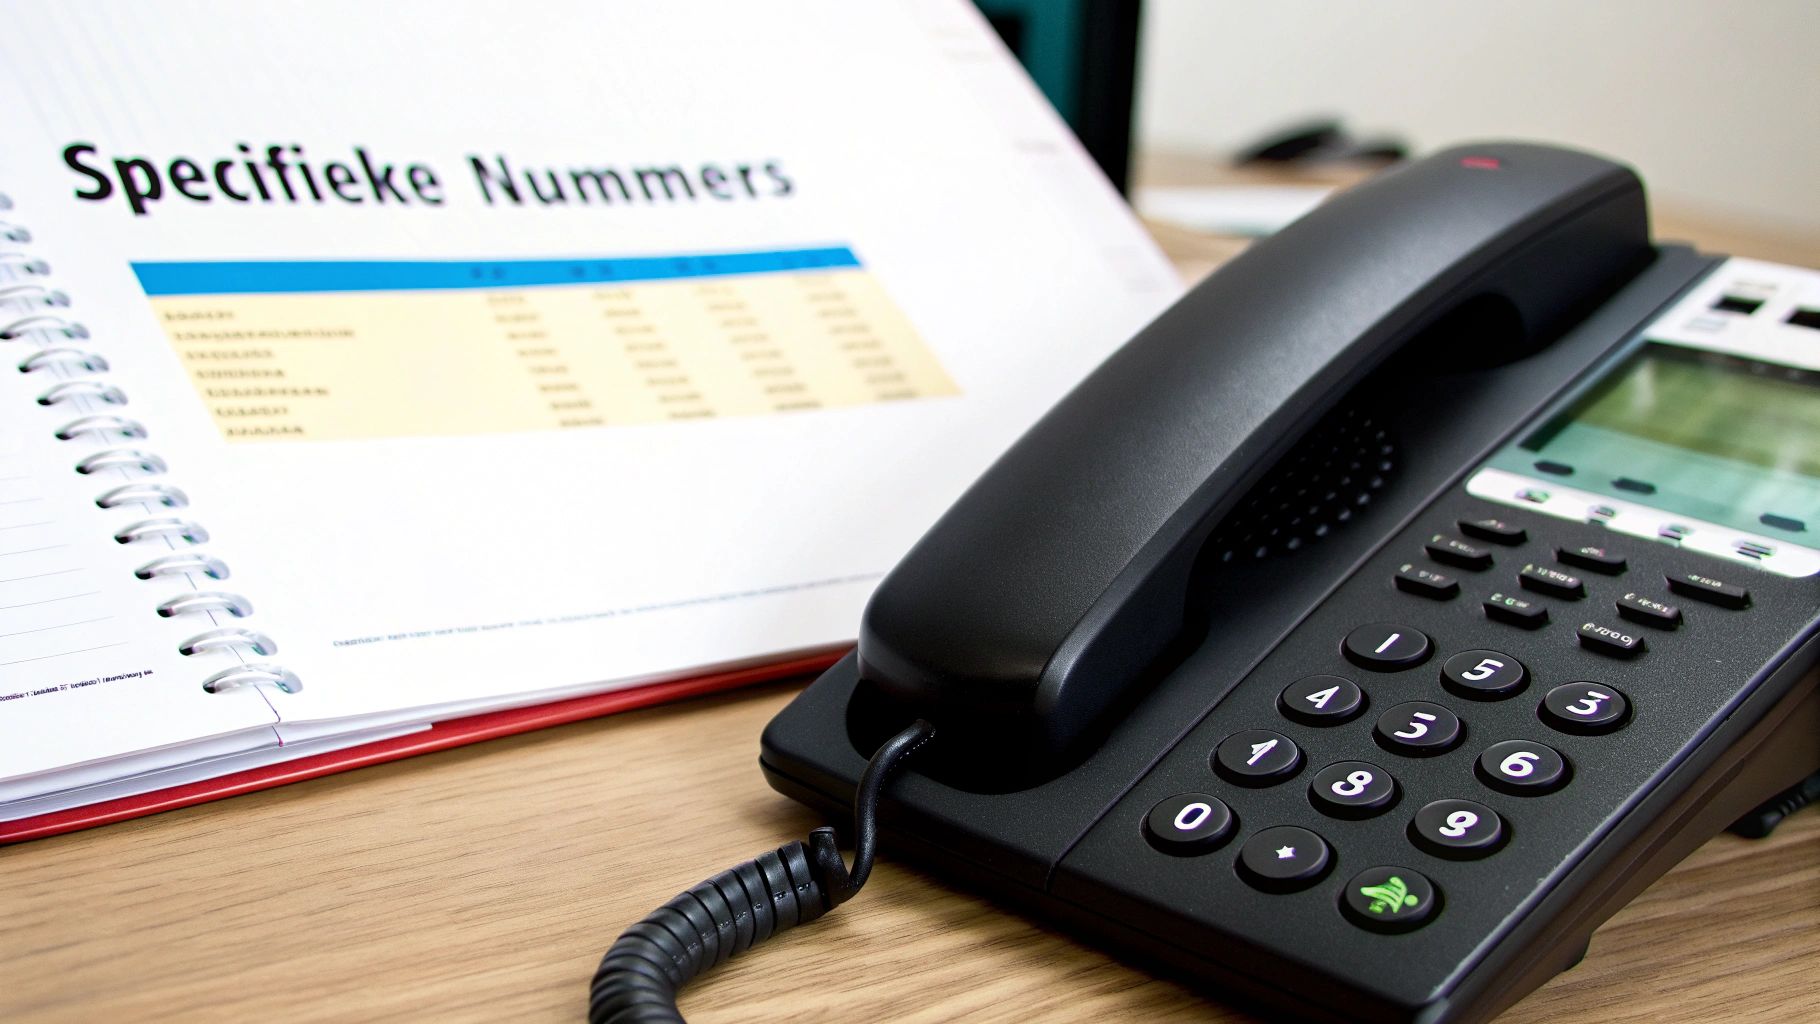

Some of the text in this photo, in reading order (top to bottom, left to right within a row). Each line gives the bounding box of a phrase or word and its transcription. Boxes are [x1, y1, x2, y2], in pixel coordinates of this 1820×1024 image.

[61, 142, 796, 217] Specifieke Nummers
[1461, 658, 1505, 681] 5
[1305, 685, 1341, 709] 4
[1499, 751, 1541, 778] 6
[1173, 802, 1213, 831] 0
